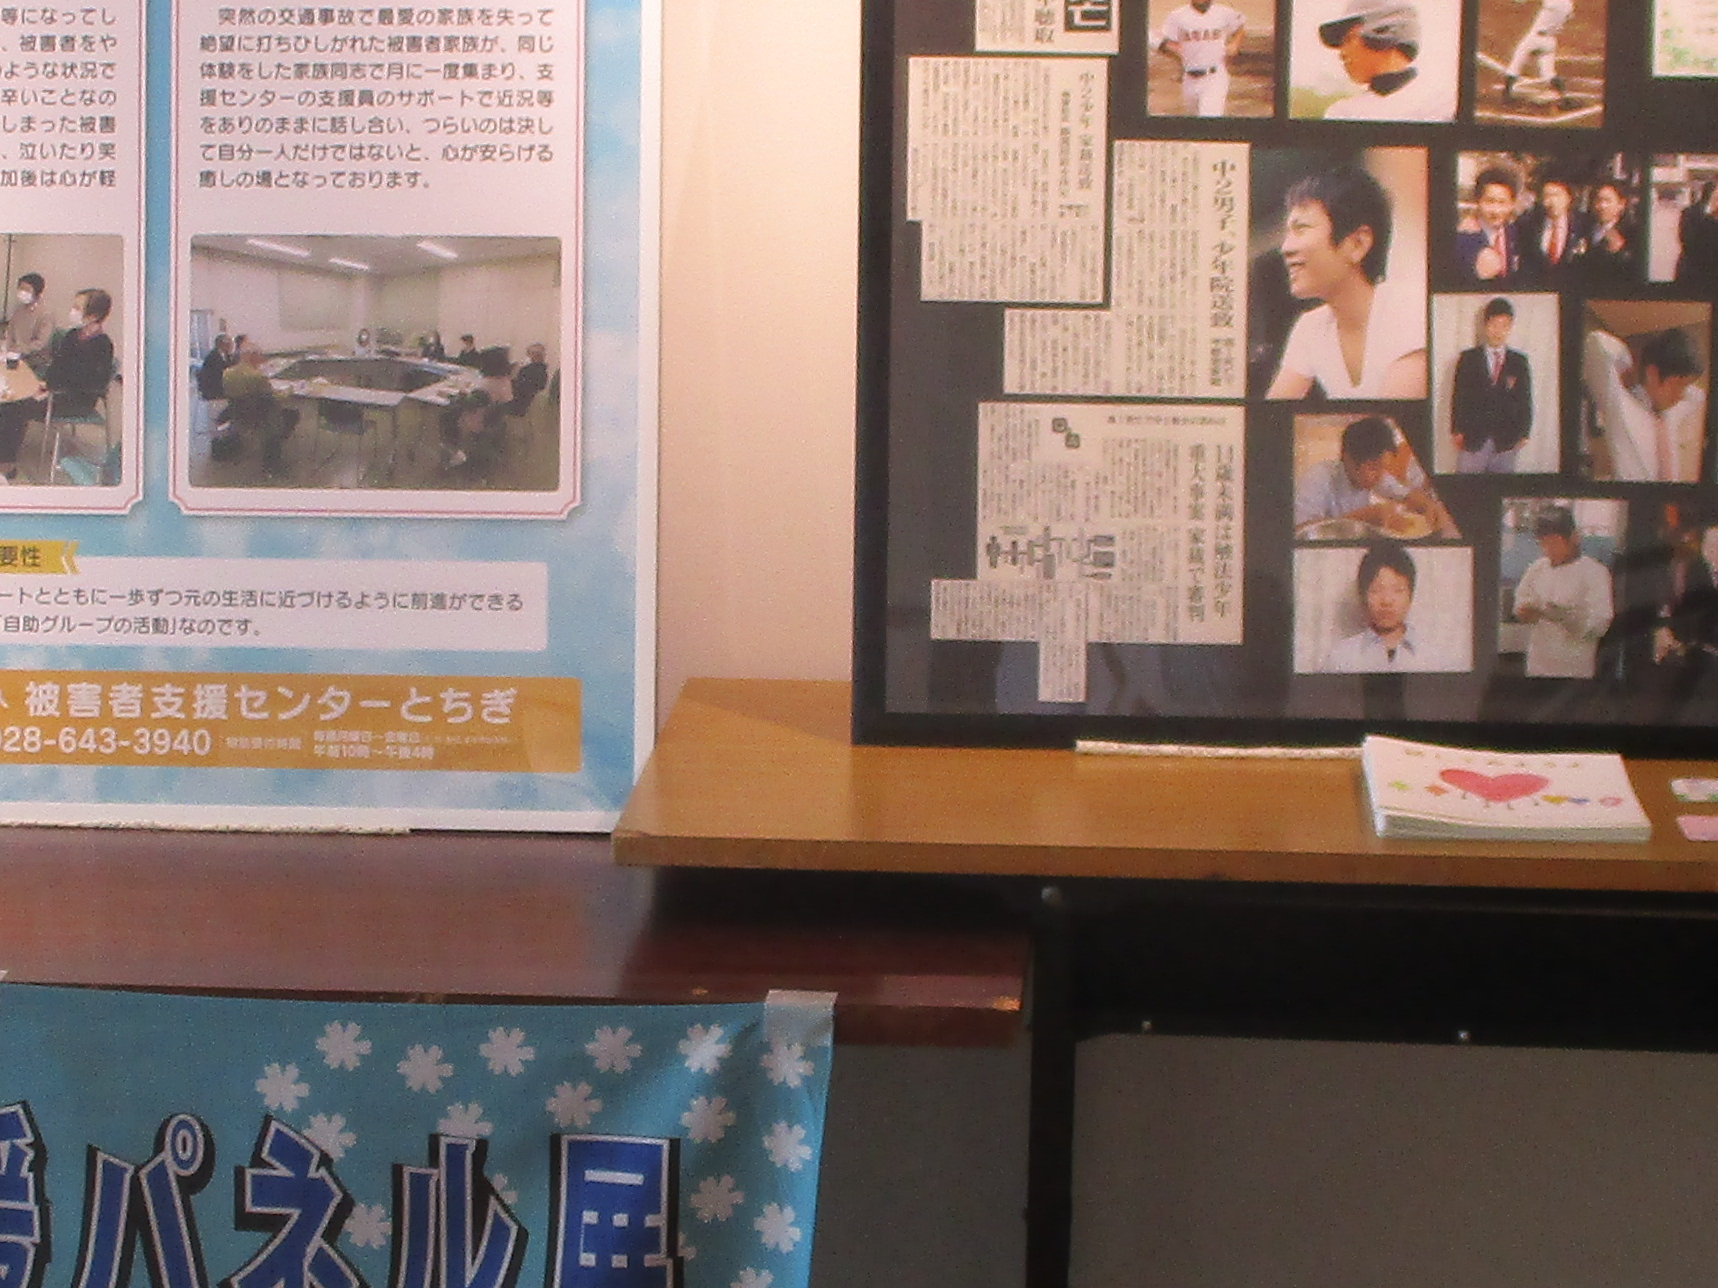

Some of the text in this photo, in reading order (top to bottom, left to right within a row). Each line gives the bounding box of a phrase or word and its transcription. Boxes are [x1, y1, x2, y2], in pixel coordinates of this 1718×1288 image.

[24, 681, 522, 726] 被害者支援センターとちぎ
